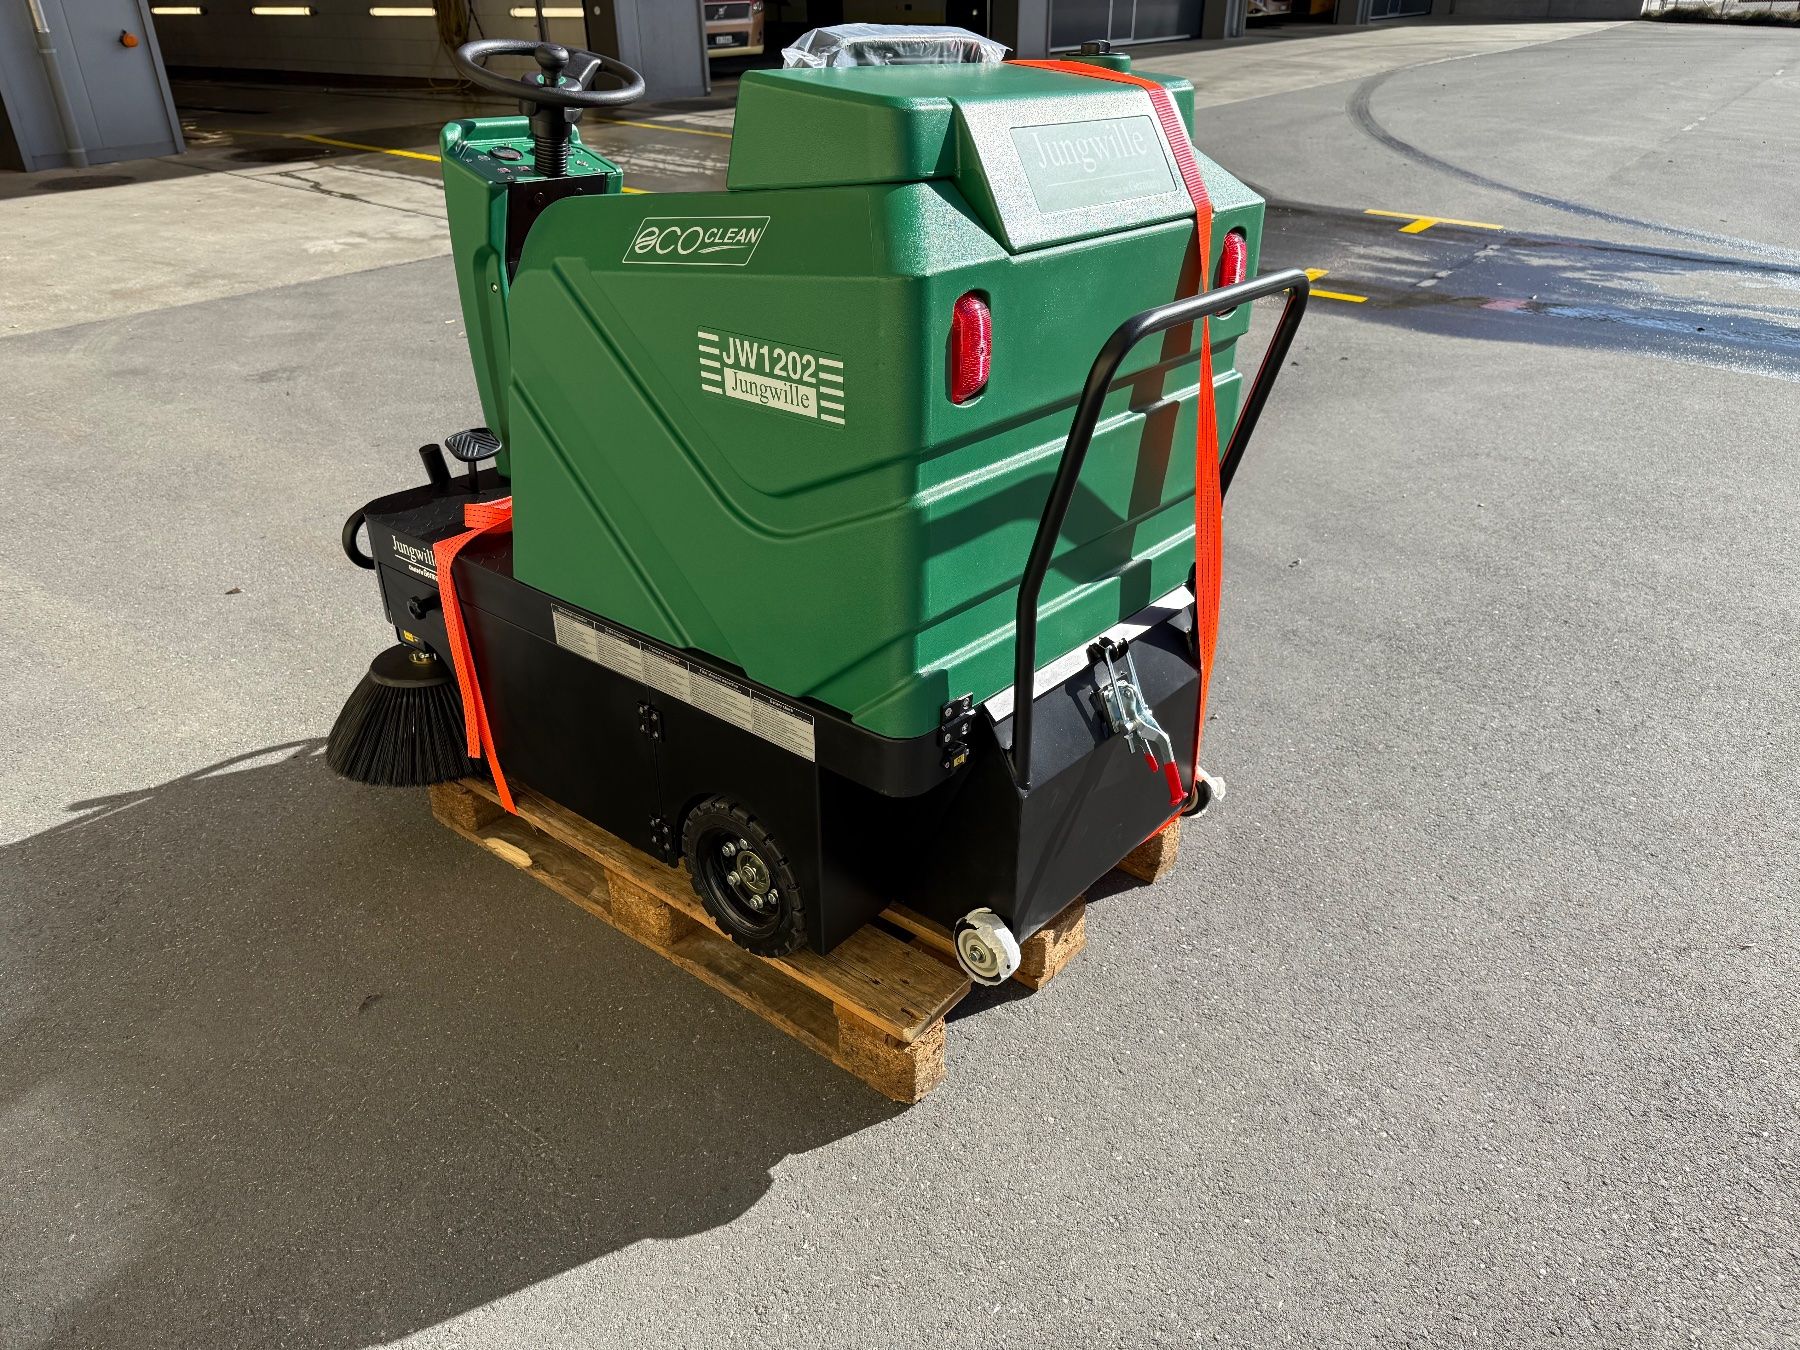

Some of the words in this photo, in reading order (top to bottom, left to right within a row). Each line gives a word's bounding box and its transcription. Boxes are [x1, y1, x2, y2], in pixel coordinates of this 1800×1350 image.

[1027, 122, 1148, 173] Jungwille
[704, 227, 762, 244] CLEAN
[722, 336, 817, 384] JW1202
[731, 371, 810, 409] Jungwille
[391, 534, 437, 567] Jungwill
